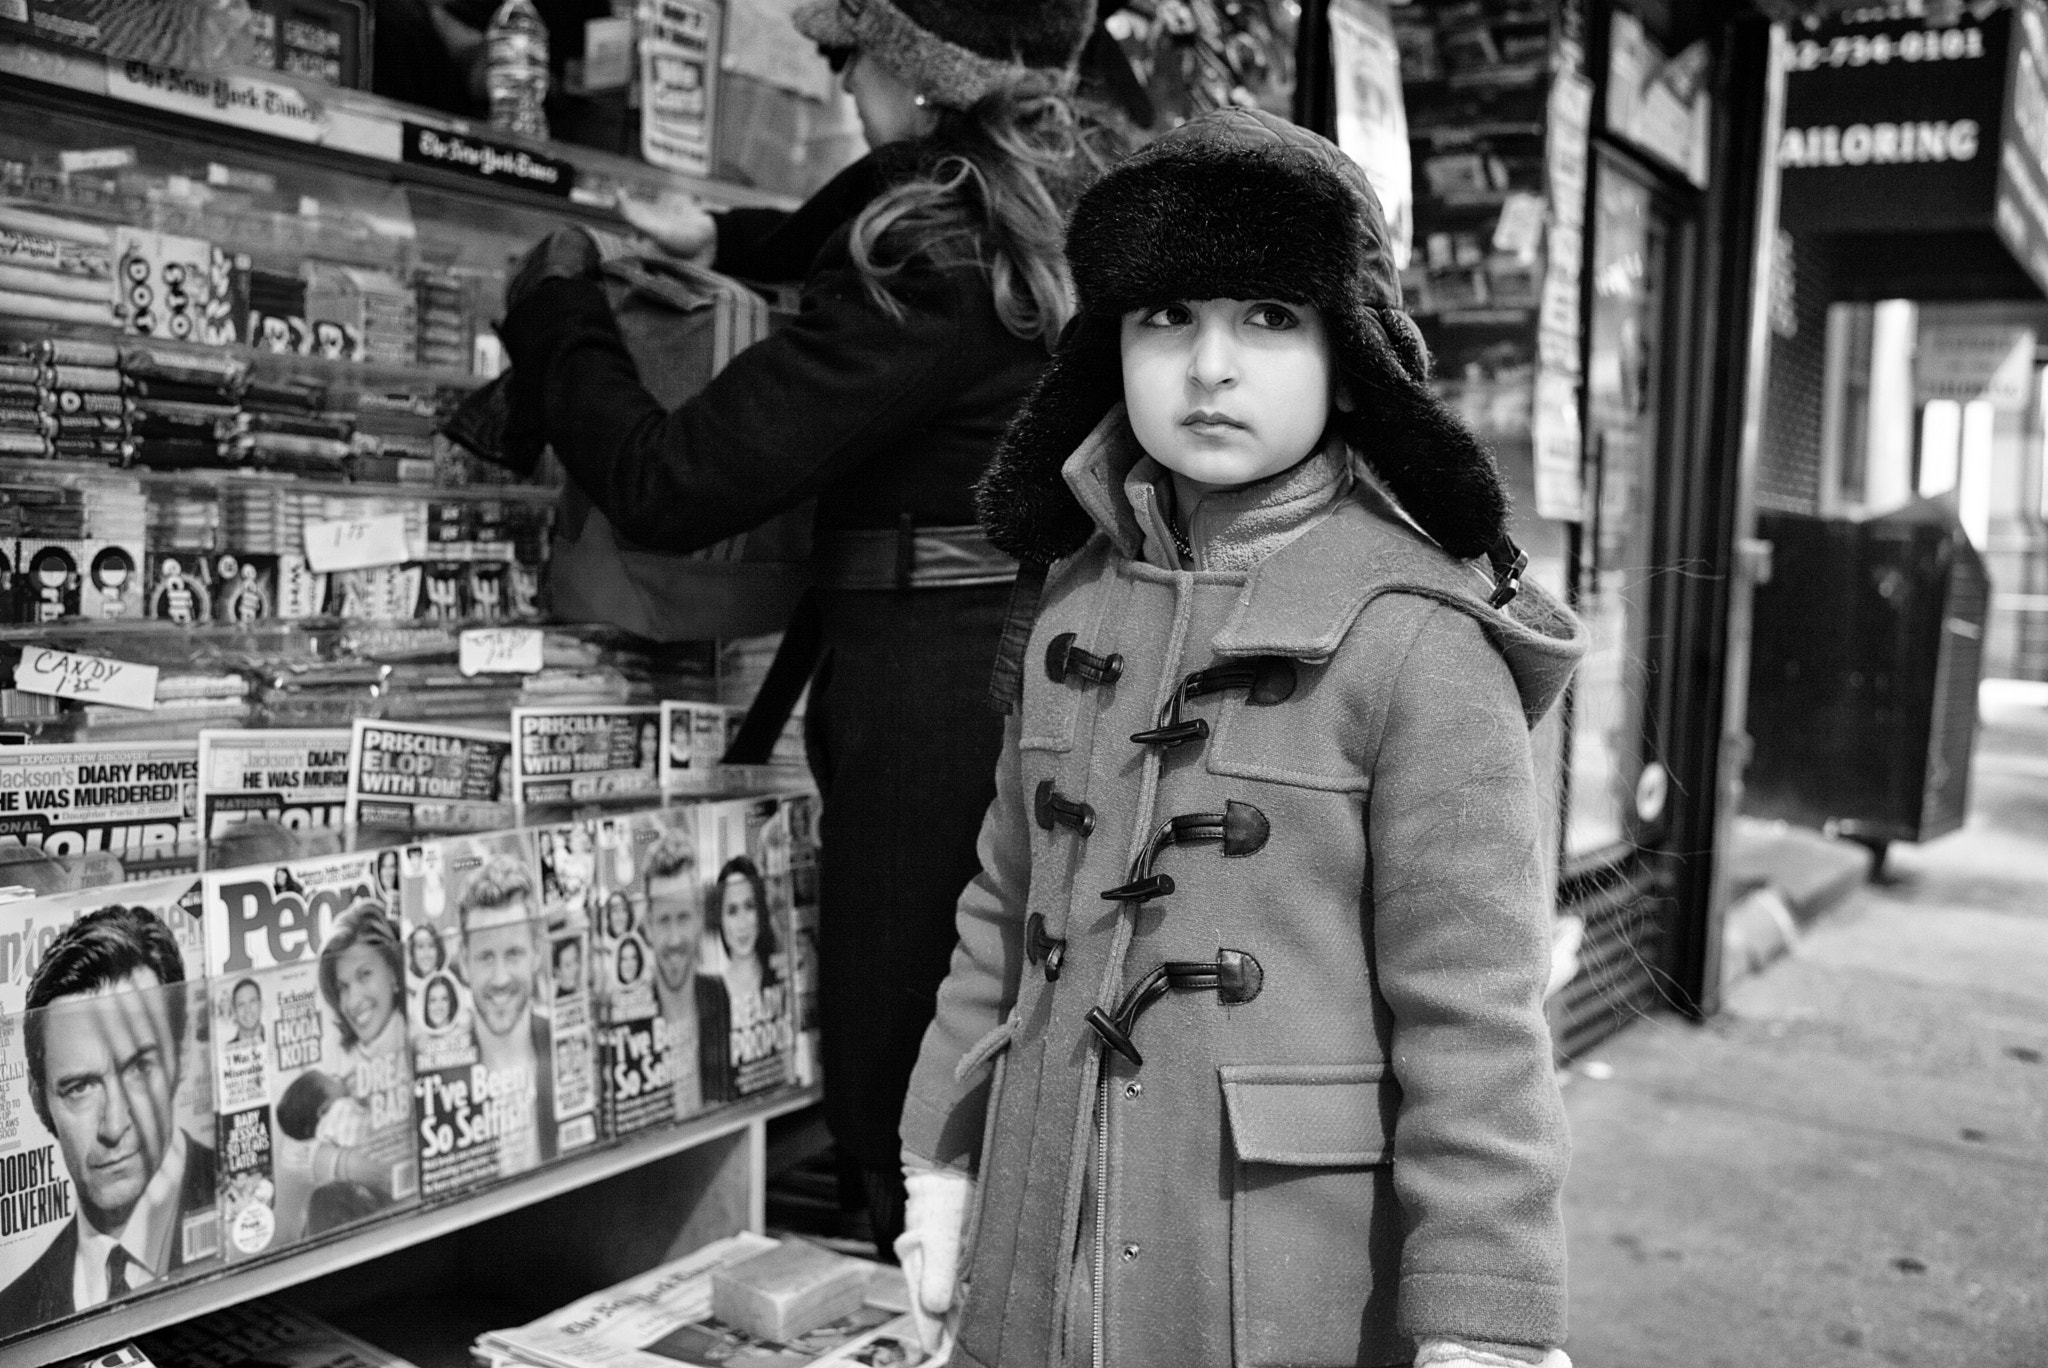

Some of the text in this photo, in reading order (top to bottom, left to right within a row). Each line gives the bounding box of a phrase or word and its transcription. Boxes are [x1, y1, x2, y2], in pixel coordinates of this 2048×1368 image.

[213, 76, 257, 110] York
[35, 651, 122, 682] CANDY
[364, 730, 462, 756] PRISCILLA
[78, 764, 132, 784] DIARY
[243, 771, 262, 789] HE
[267, 770, 299, 788] WAS
[361, 773, 416, 794] WITH
[26, 788, 70, 810] WAS
[74, 783, 178, 807] MURDERED!
[421, 1115, 453, 1158] So
[0, 1180, 71, 1237] OLVERINE
